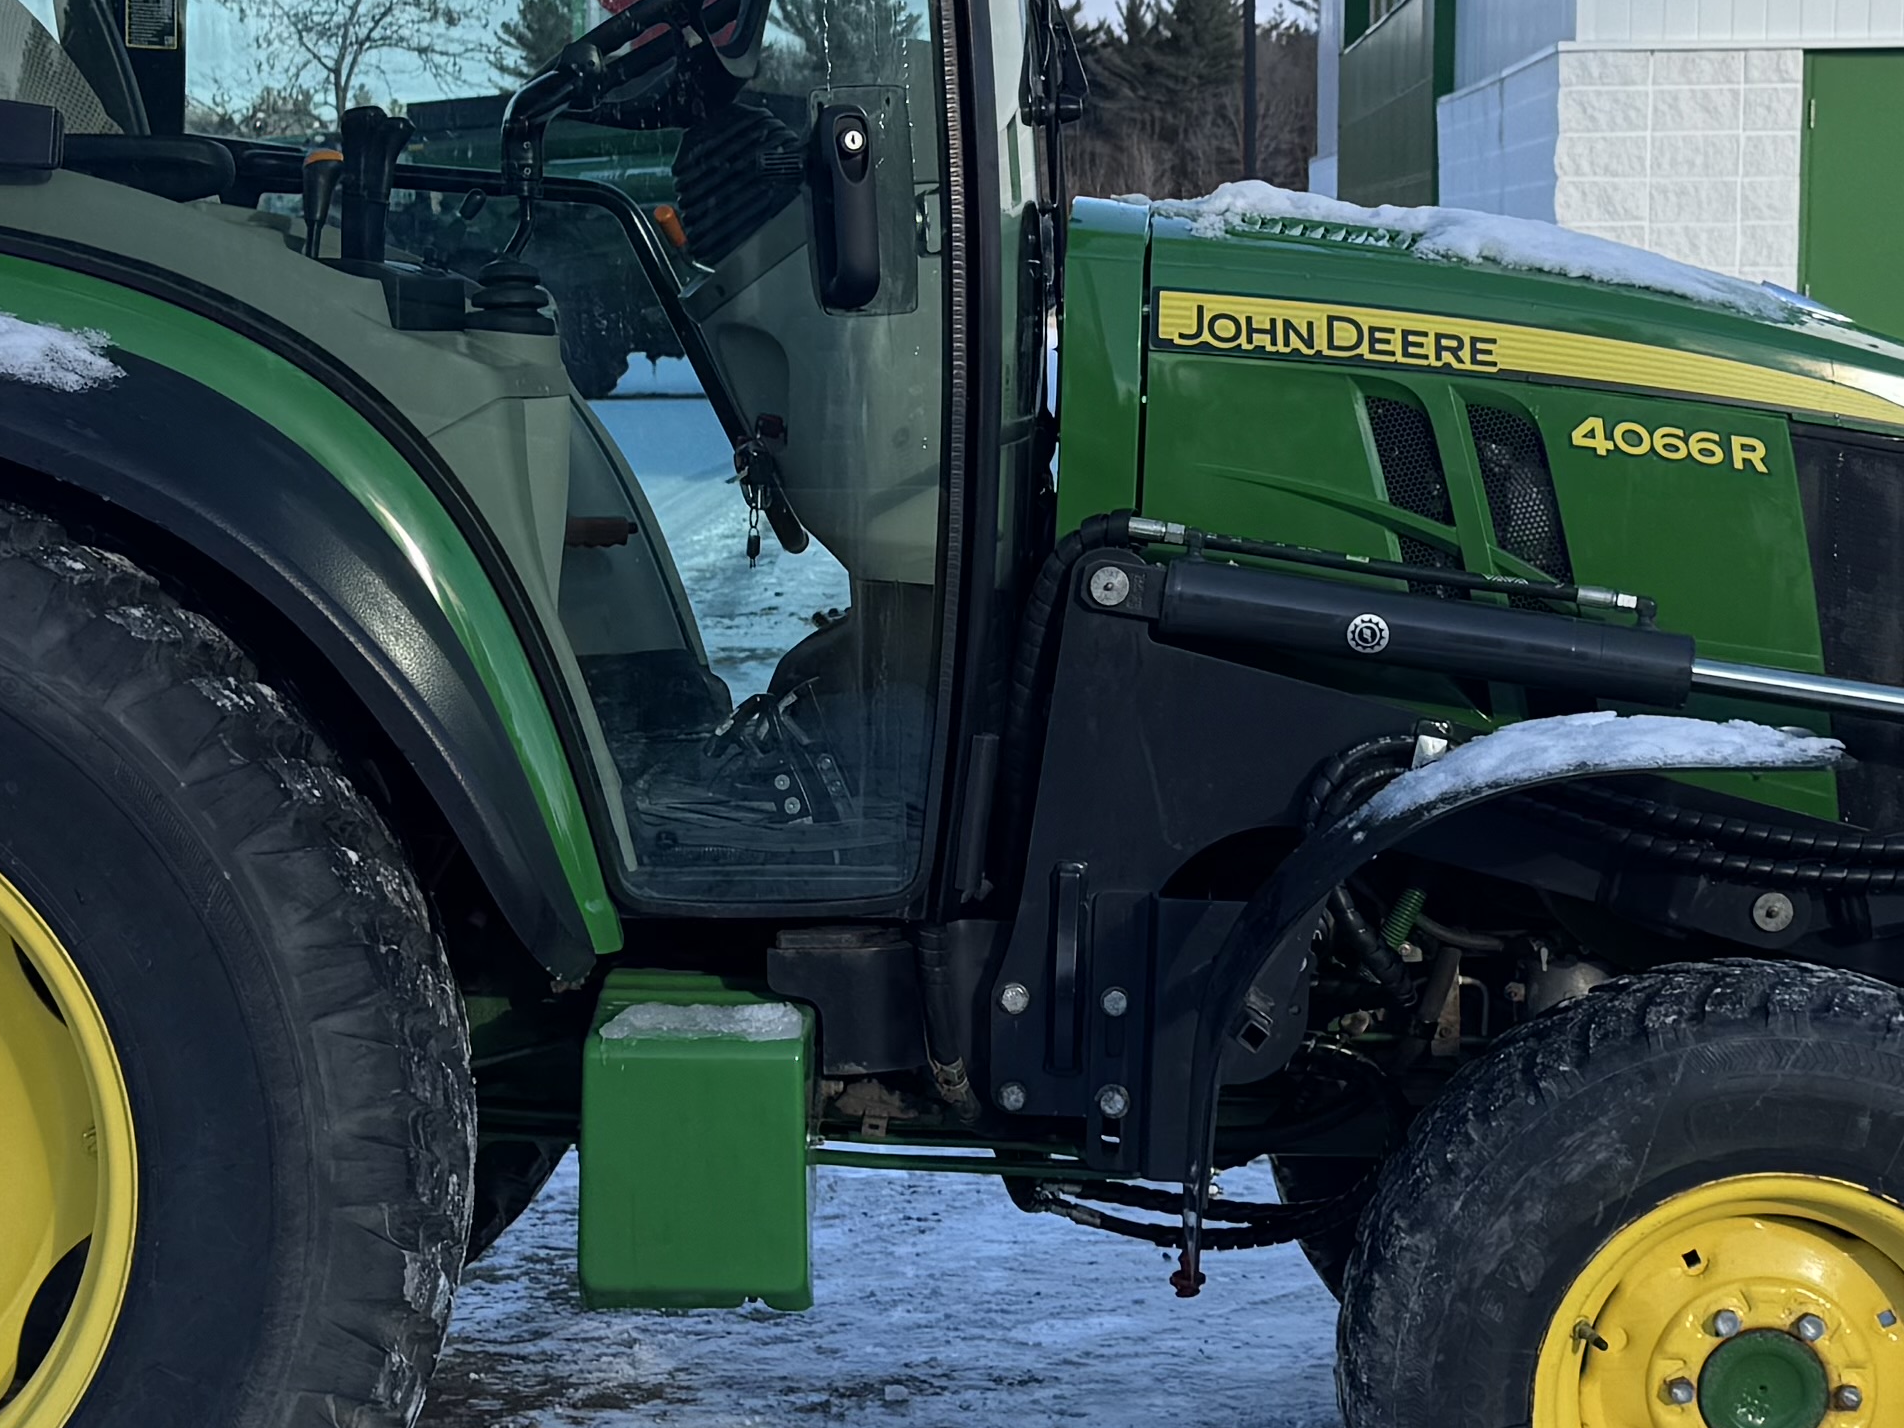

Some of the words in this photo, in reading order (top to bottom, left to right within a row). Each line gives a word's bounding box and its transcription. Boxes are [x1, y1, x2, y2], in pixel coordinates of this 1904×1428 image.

[1177, 304, 1315, 350] JOHN
[1326, 314, 1499, 368] DEERE
[1571, 416, 1769, 474] 4066R
